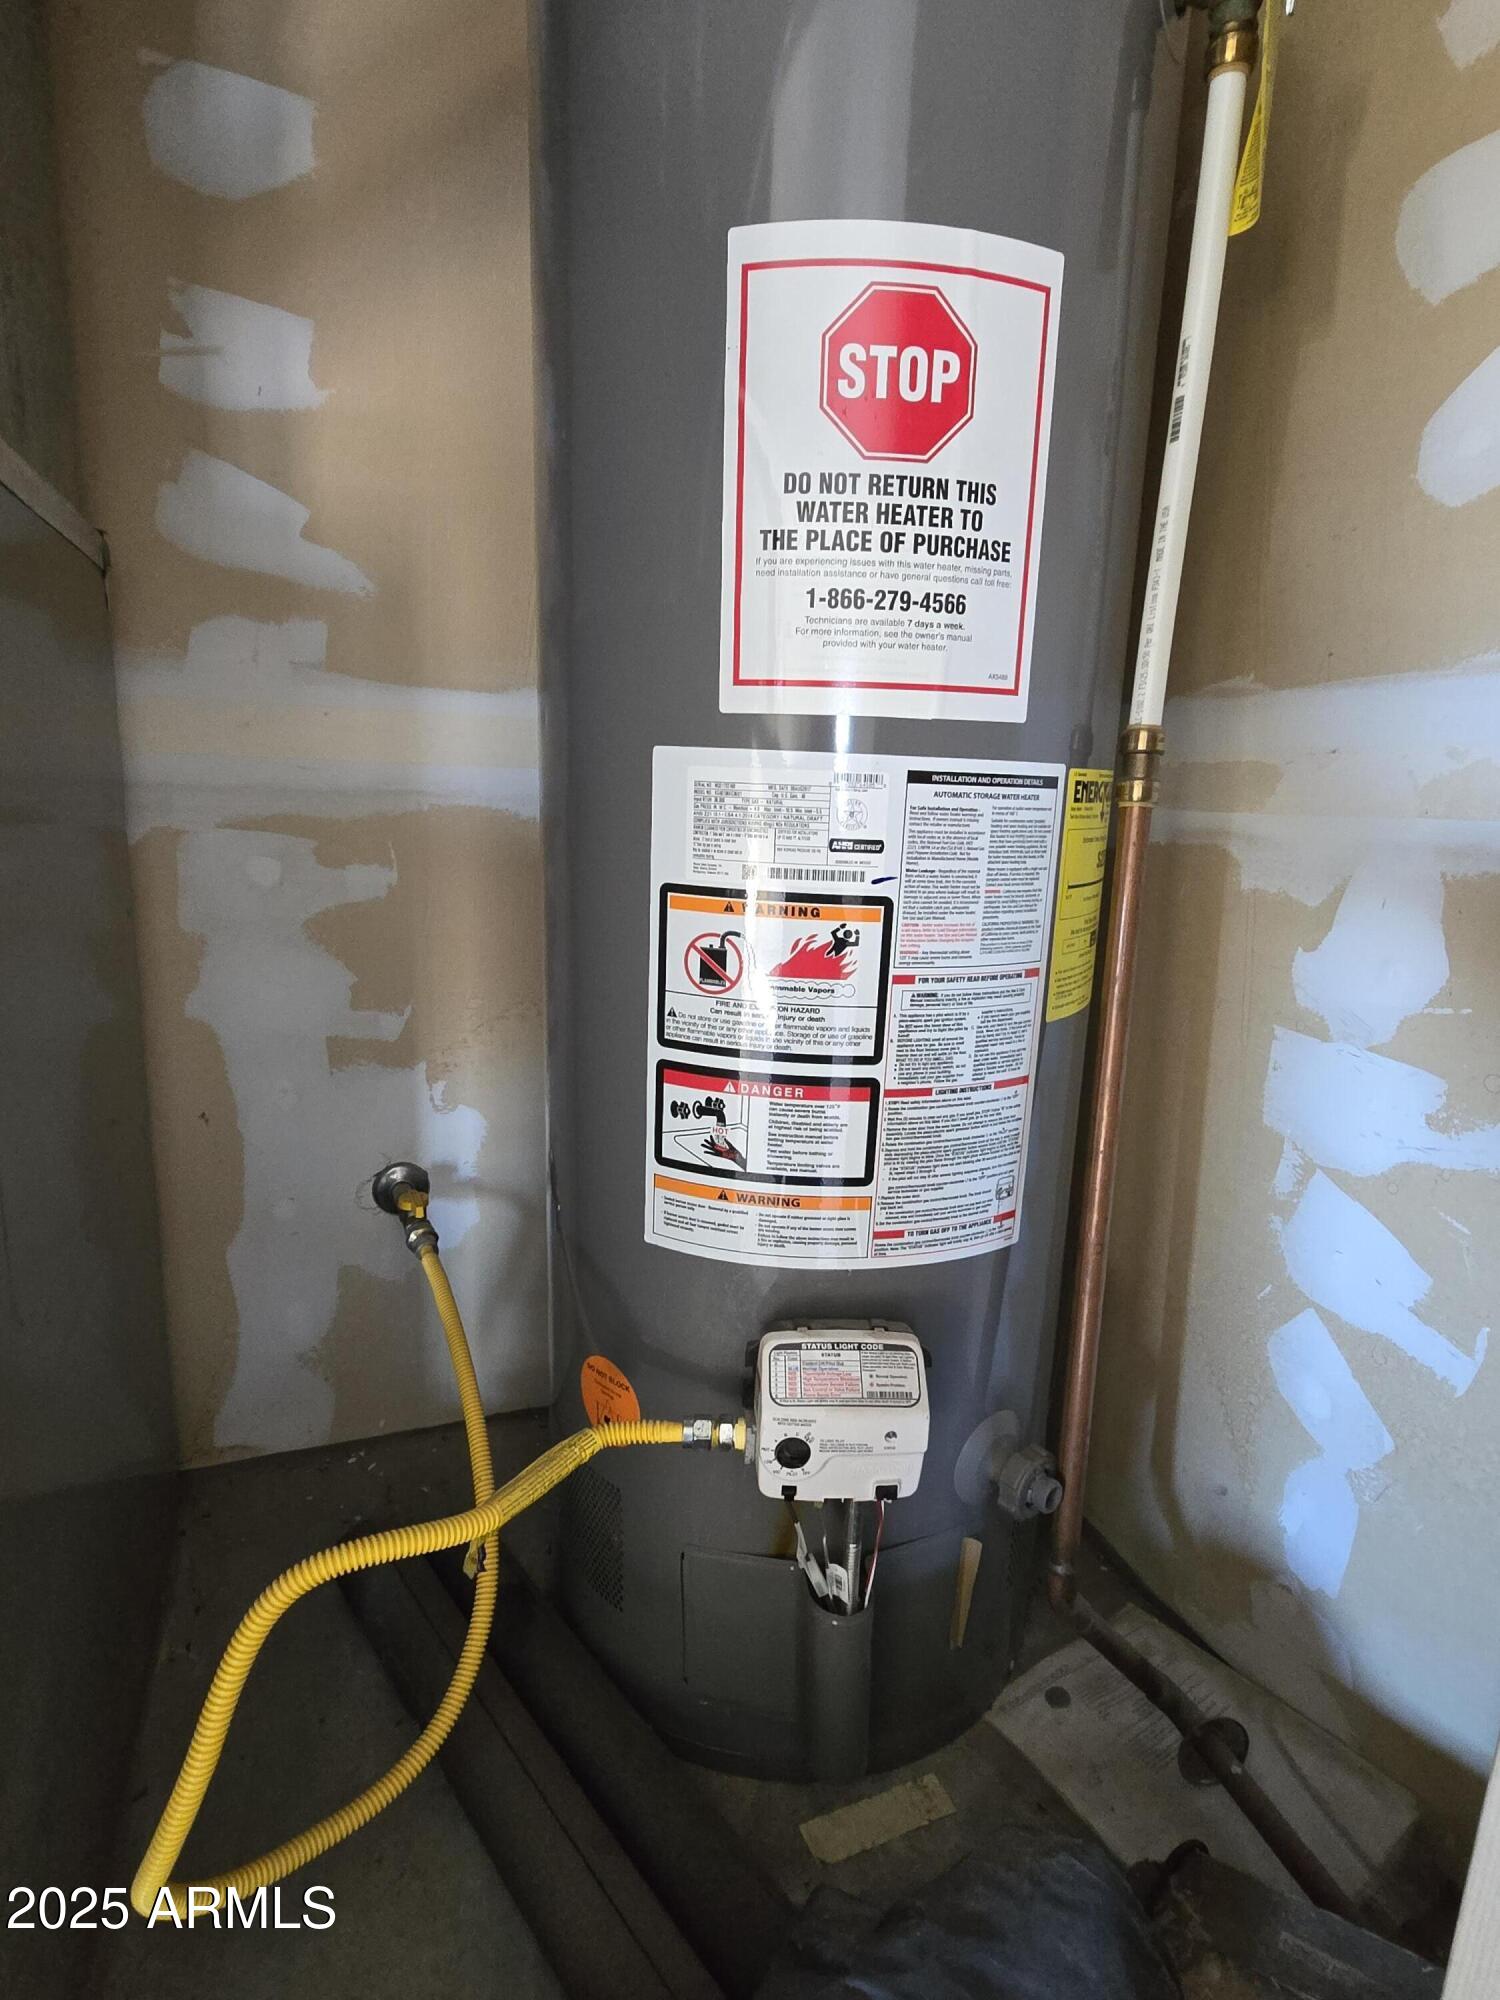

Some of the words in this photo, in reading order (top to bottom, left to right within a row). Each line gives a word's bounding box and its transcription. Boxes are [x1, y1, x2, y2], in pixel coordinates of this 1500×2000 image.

[838, 343, 960, 403] STOP
[784, 472, 811, 494] DO
[820, 472, 861, 494] NOT
[868, 474, 949, 500] RETURN
[956, 480, 996, 505] THIS
[797, 501, 868, 523] WATER
[876, 502, 953, 528] HEATER
[960, 509, 983, 532] TO
[760, 529, 798, 550] THE
[806, 530, 872, 552] PLACE
[880, 531, 906, 553] OF
[913, 533, 1011, 562] PURCHASE
[796, 558, 847, 567] experiencing
[878, 560, 894, 568] with
[913, 561, 934, 570] water
[937, 562, 962, 572] heater,
[965, 565, 991, 576] missing
[993, 568, 1012, 578] parts,
[756, 568, 775, 576] need
[778, 568, 820, 577] installation
[824, 569, 866, 578] assistance
[880, 571, 899, 579] have
[902, 572, 931, 581] general
[934, 574, 968, 584] questions
[971, 575, 982, 585] call
[806, 588, 966, 615] 1-866-279-4566
[805, 616, 852, 625] Technicians
[870, 618, 905, 627] available
[915, 620, 934, 629] days
[944, 622, 965, 630] week.
[834, 629, 881, 638] information,
[823, 639, 857, 648] provided
[860, 640, 876, 648] with
[932, 775, 977, 783] INSTALLATION
[741, 1083, 804, 1098] DANGER
[959, 1084, 992, 1094] INSTRUCTIONS
[737, 1192, 801, 1207] WARNING
[968, 1219, 992, 1229] APPLIANCE
